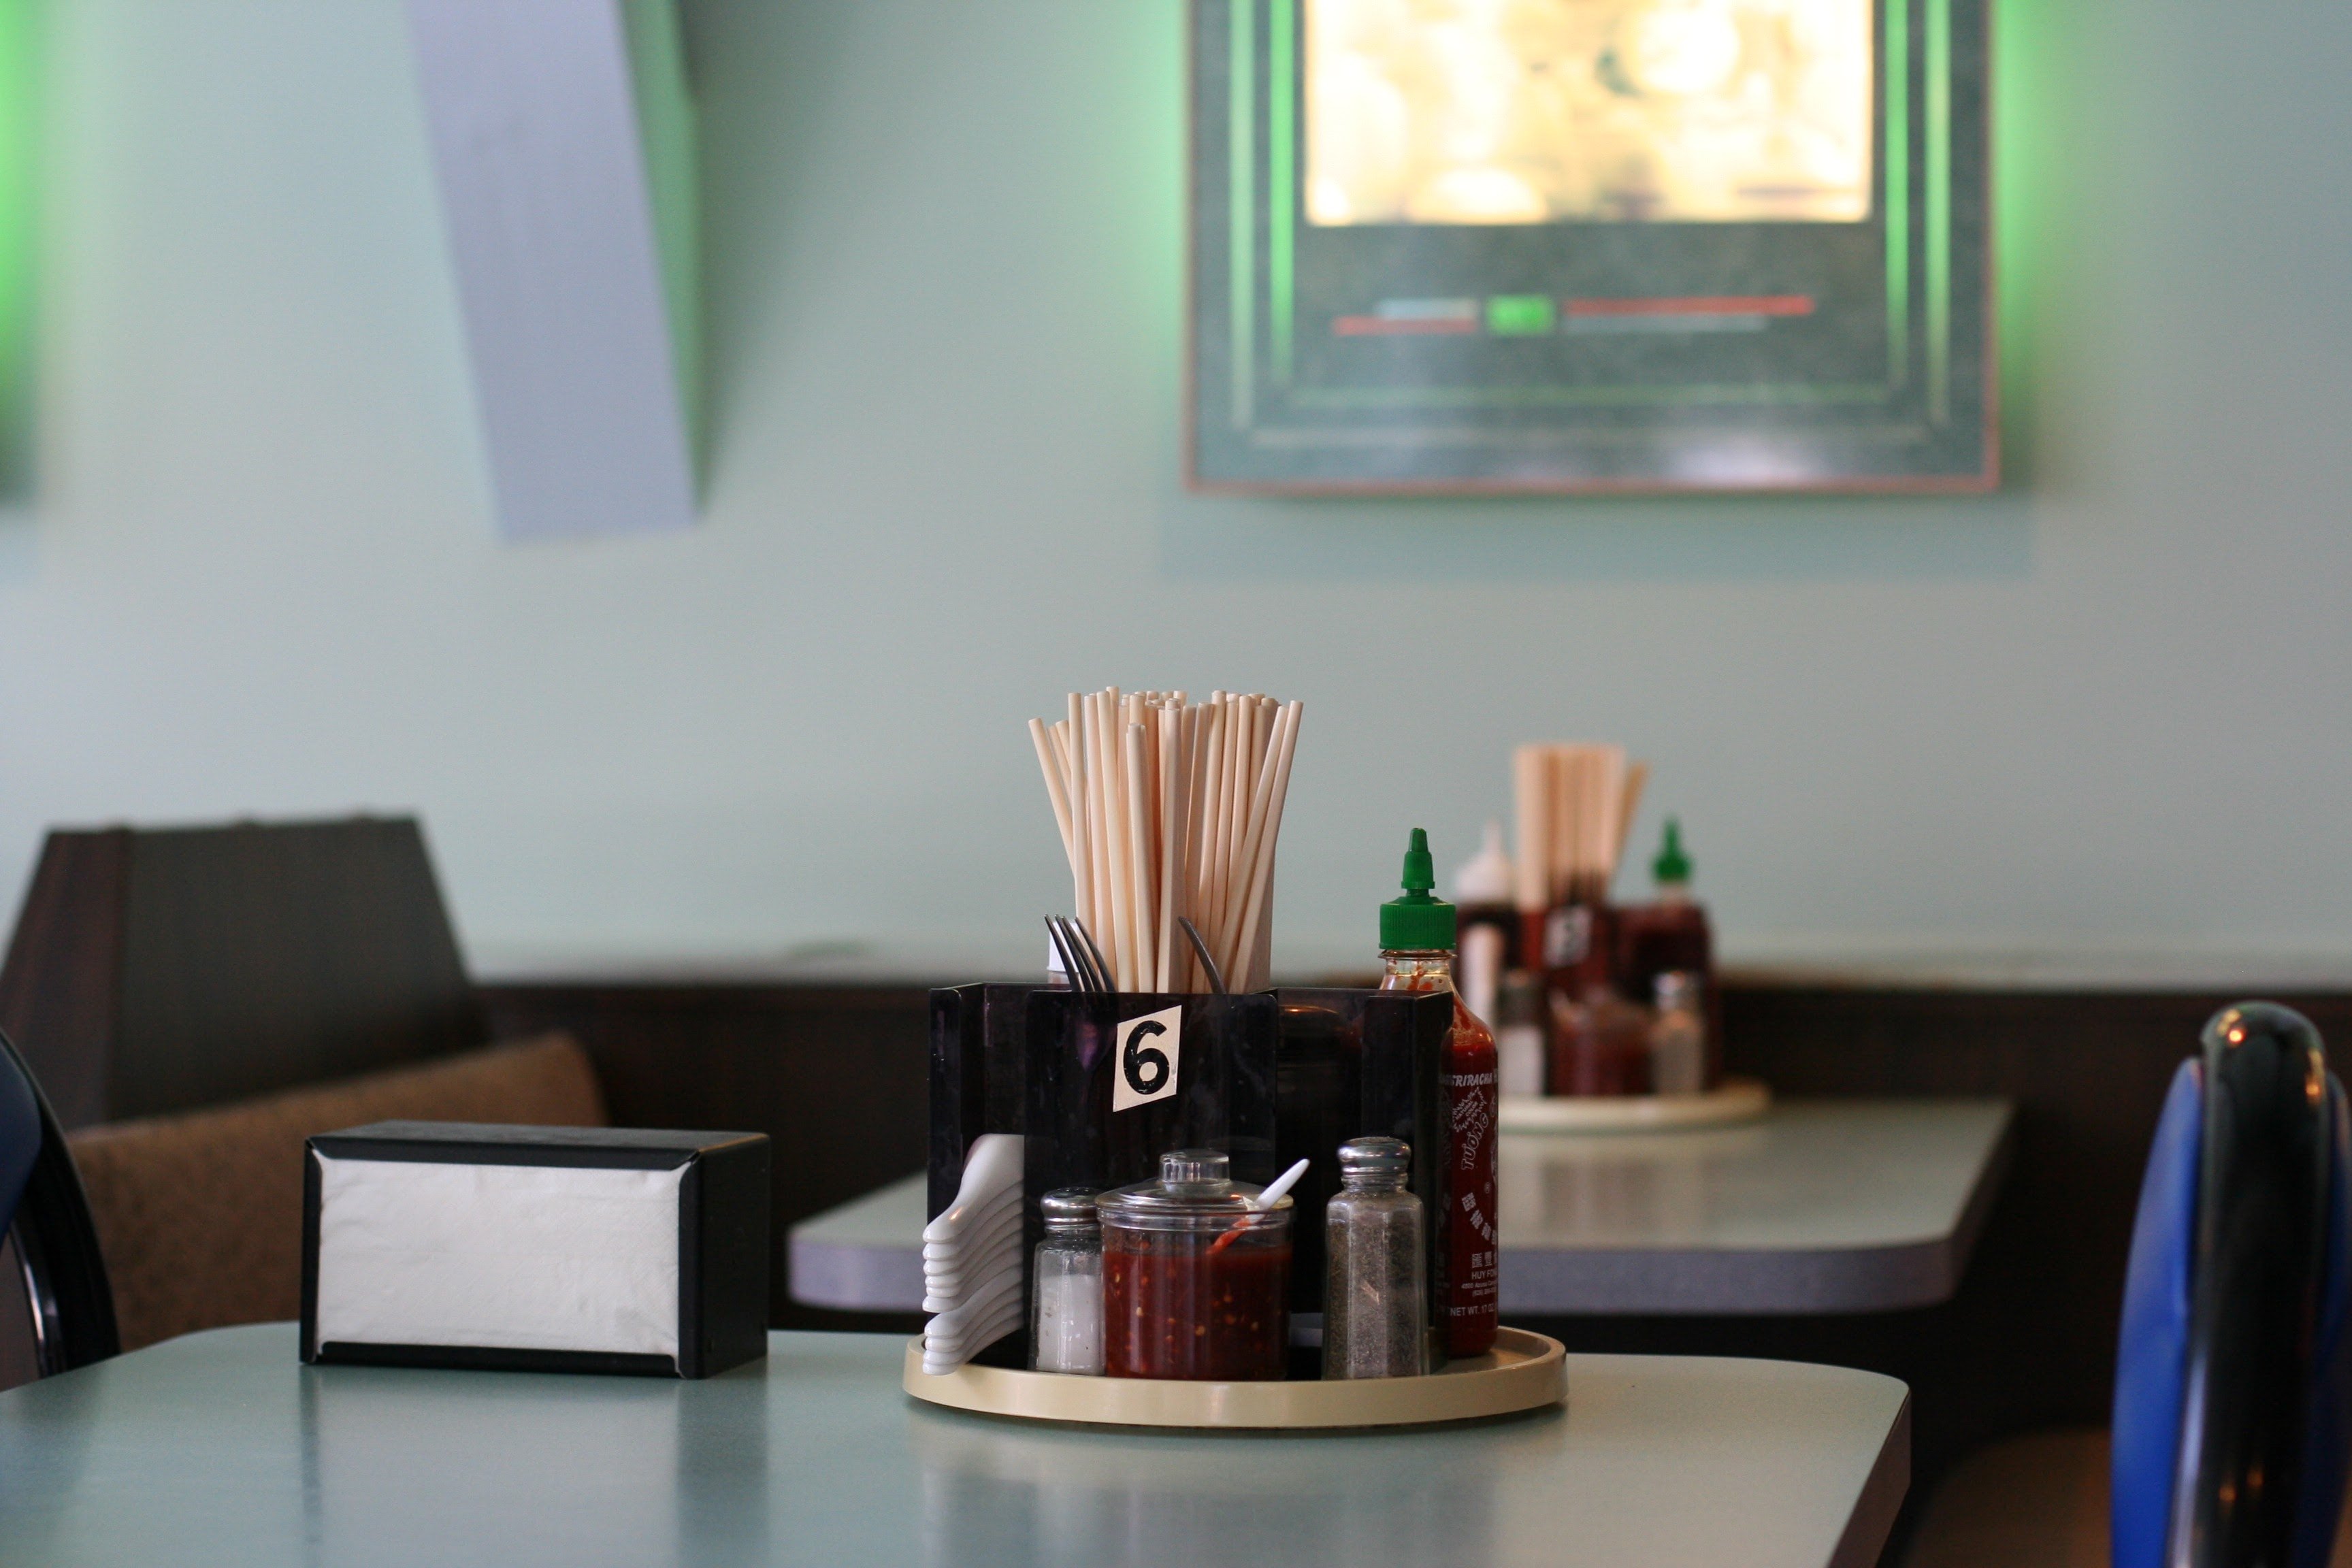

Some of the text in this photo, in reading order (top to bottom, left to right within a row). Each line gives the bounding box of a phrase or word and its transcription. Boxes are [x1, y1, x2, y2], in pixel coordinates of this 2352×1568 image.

[1123, 1020, 1170, 1095] 6
[1448, 1073, 1492, 1087] SRIRACHA
[1471, 1271, 1486, 1279] HUY
[1450, 1306, 1467, 1317] NET
[1467, 1305, 1480, 1316] WT.
